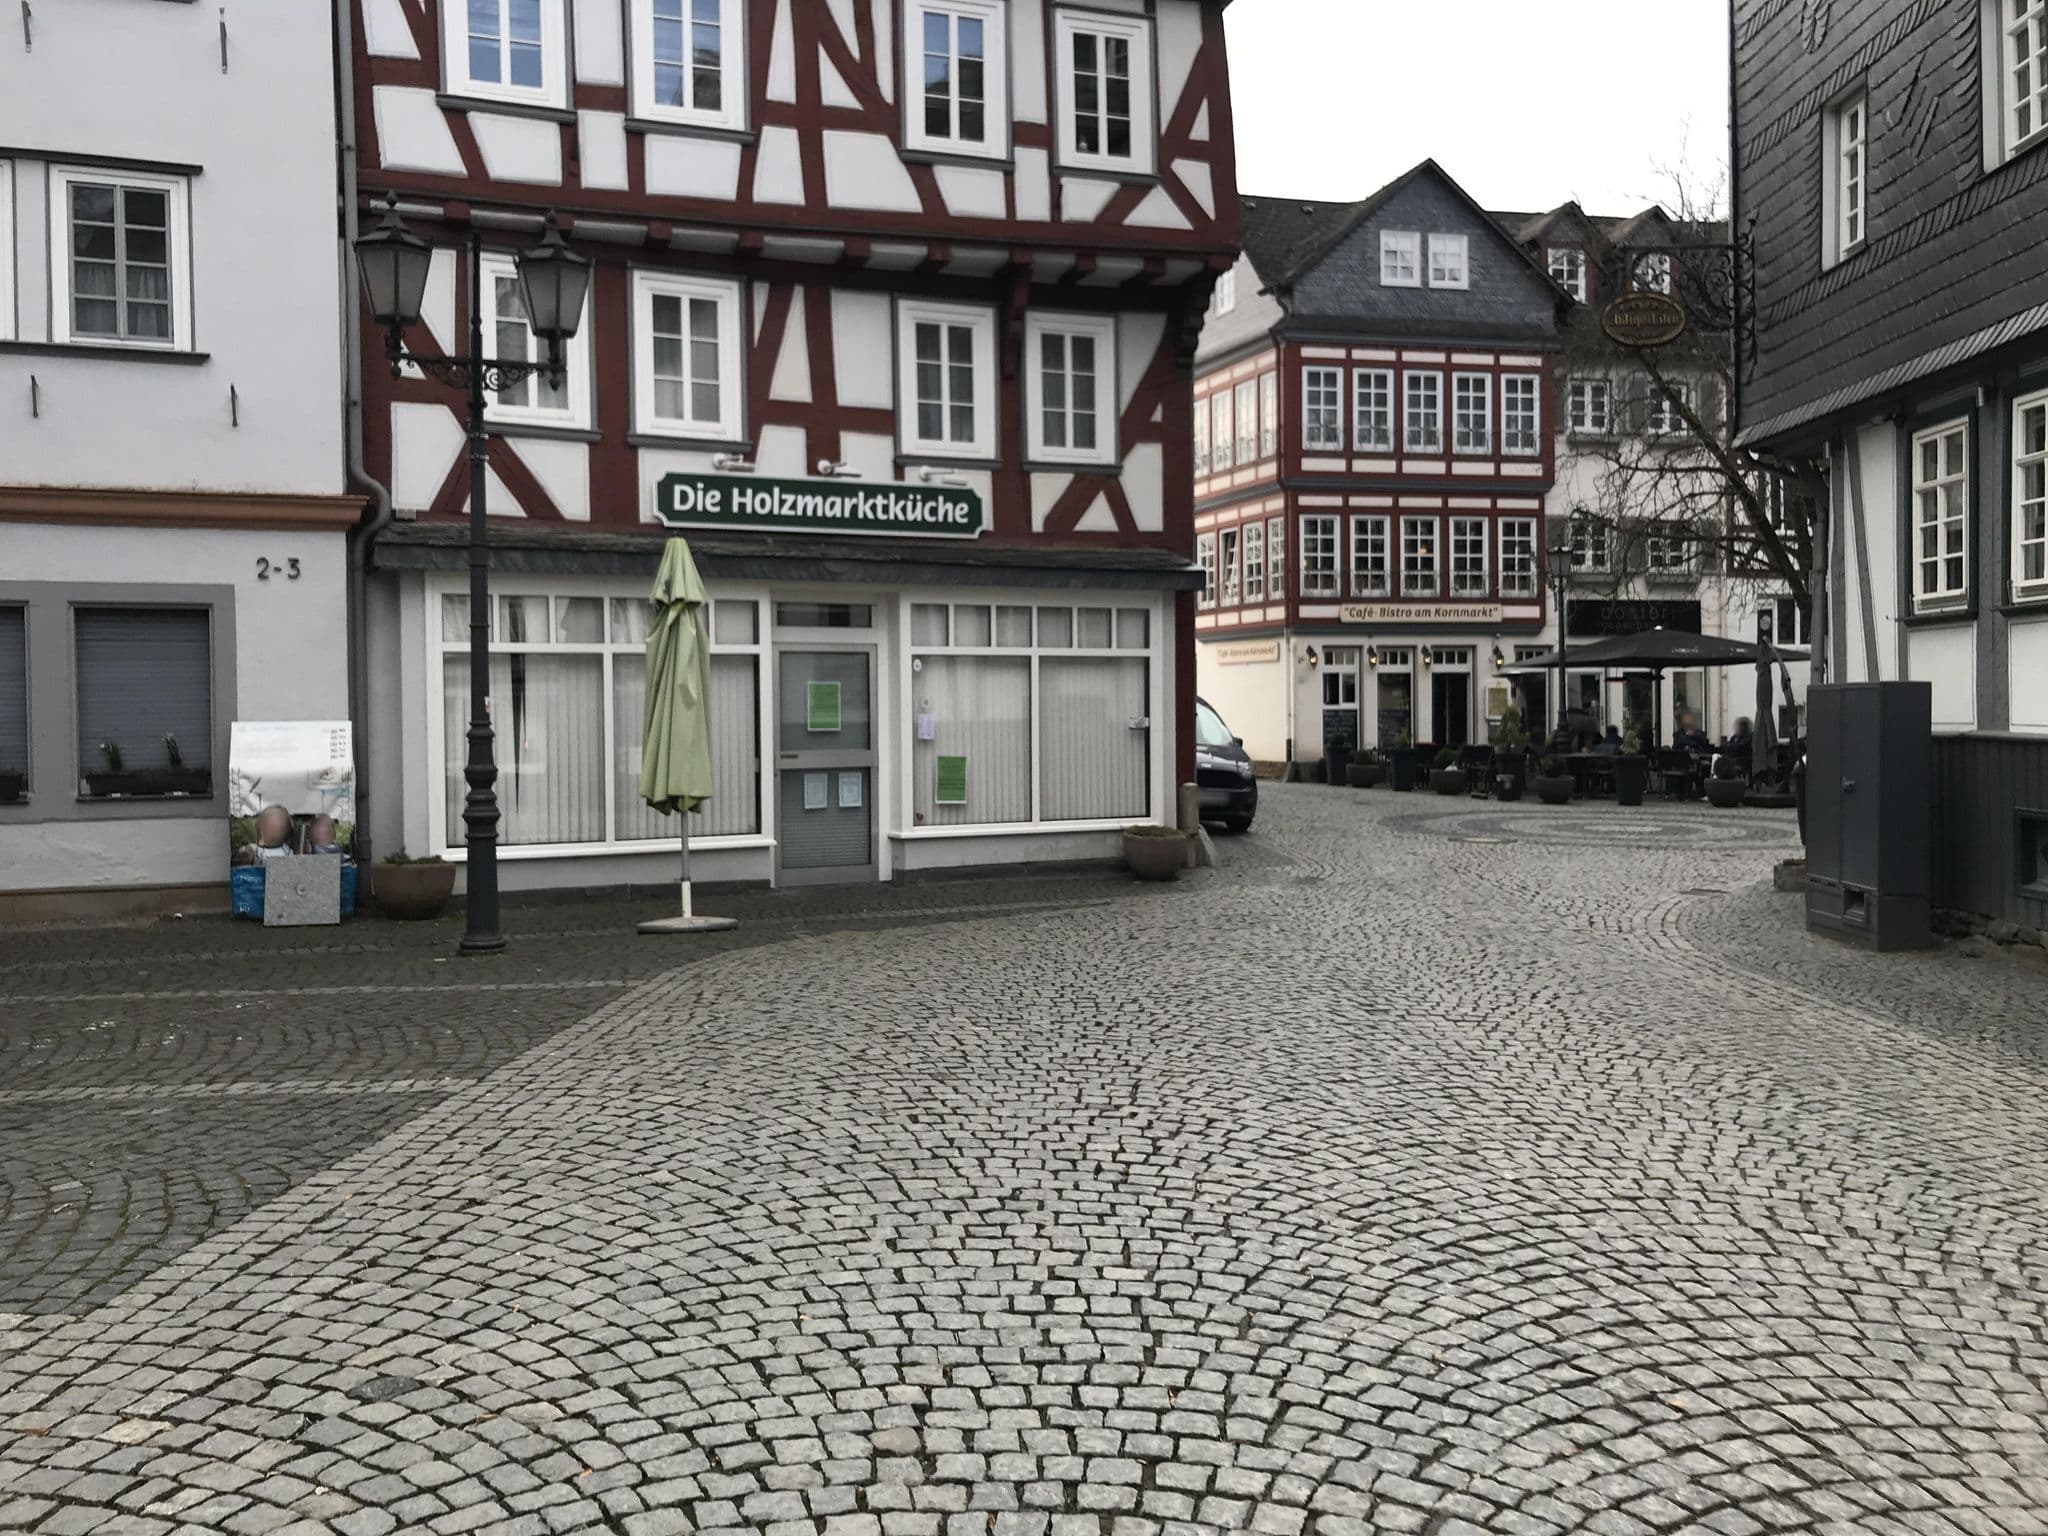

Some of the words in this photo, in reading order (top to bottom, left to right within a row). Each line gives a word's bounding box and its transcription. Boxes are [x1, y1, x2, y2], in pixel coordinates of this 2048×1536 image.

[673, 483, 722, 513] Die
[732, 486, 969, 525] Holzmarktküche
[256, 556, 301, 580] 2-3
[1414, 608, 1431, 617] am
